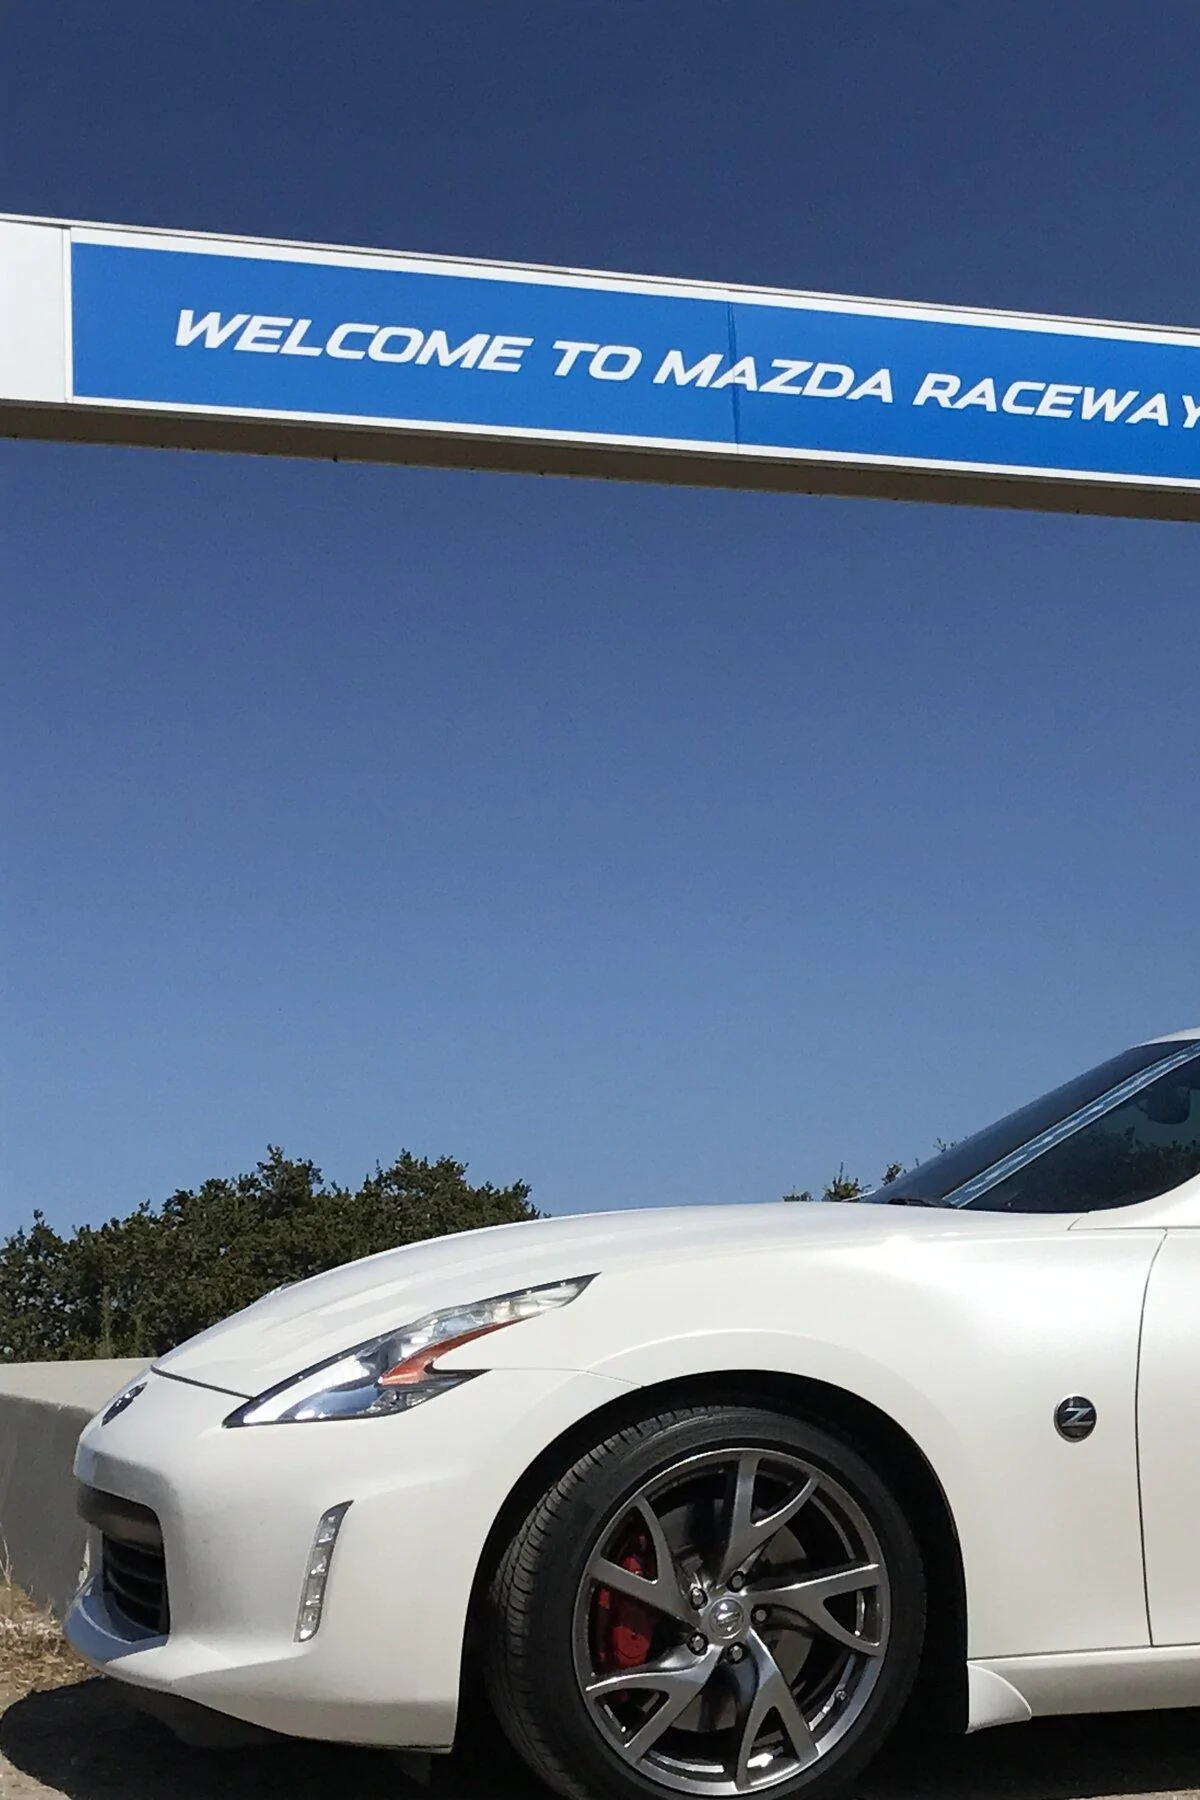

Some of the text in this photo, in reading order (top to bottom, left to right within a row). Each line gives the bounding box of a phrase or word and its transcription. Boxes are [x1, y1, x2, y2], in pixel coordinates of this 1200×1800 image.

[175, 309, 533, 372] WELCOME
[553, 341, 642, 381] TO
[653, 349, 893, 403] MAZDA
[1061, 1406, 1094, 1427] Z
